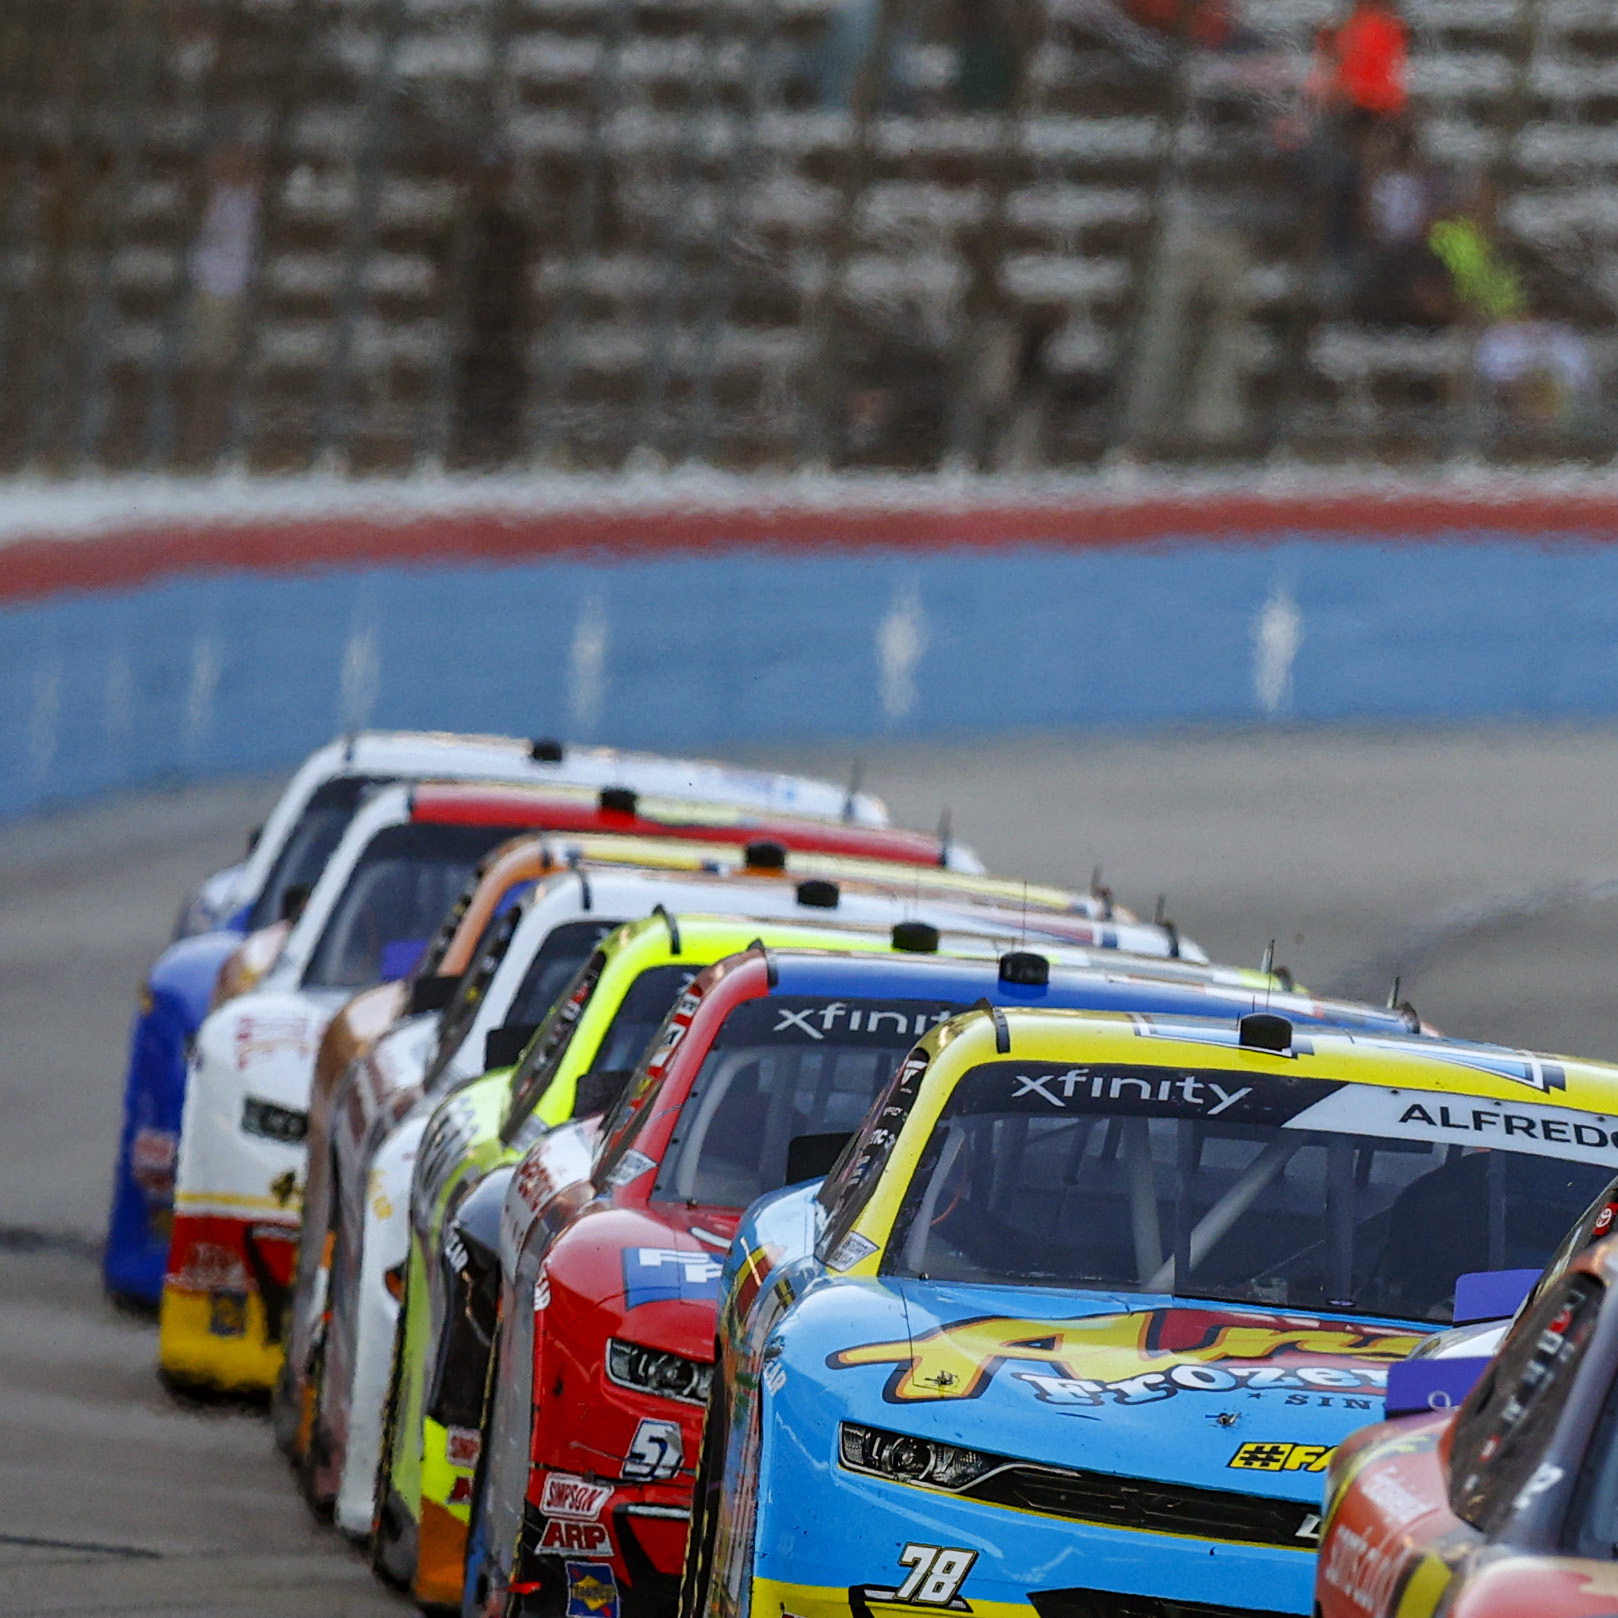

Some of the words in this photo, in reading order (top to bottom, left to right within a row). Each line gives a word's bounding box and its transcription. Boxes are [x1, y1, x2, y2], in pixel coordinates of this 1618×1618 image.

[772, 1002, 949, 1040] xfini
[1011, 1068, 1253, 1115] xfinity
[1283, 1393, 1373, 1410] SIN
[543, 1522, 607, 1550] ARP
[896, 1543, 978, 1607] 78
